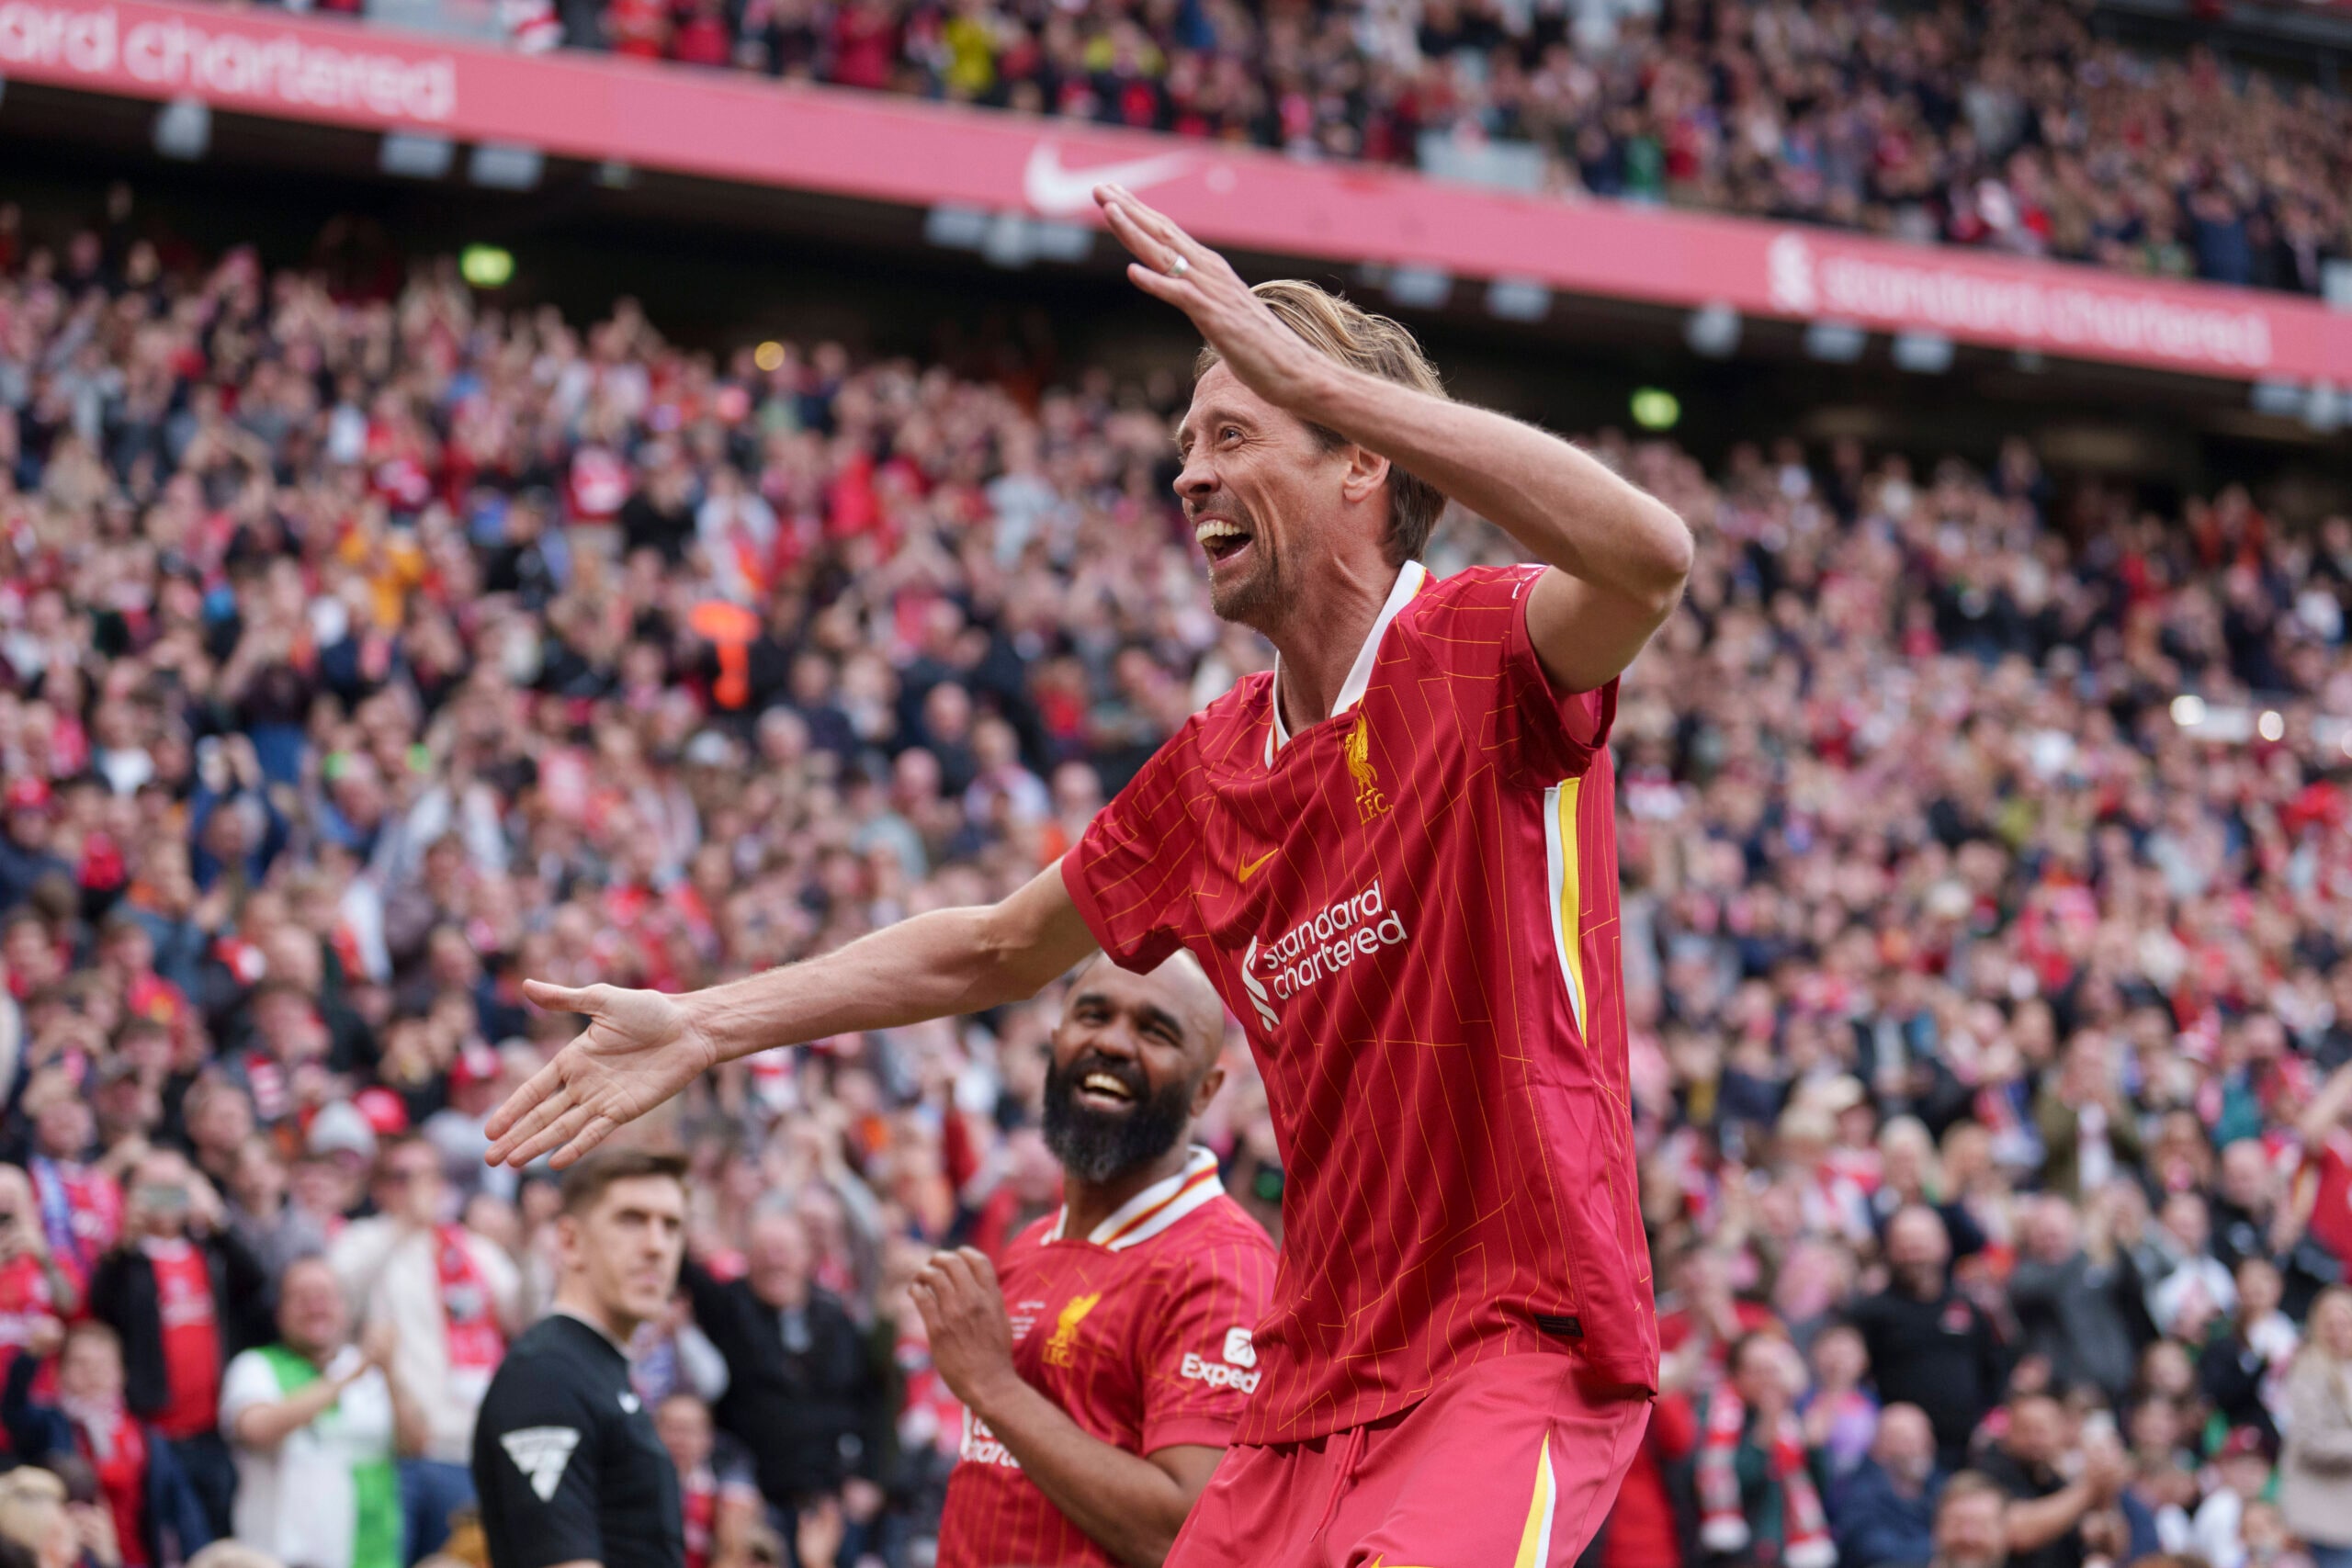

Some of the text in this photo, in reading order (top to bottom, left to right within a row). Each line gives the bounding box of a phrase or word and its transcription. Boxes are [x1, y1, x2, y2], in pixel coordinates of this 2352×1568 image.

[123, 17, 457, 120] chartered
[1263, 880, 1383, 970] standard
[1273, 909, 1408, 1000] chartered
[1181, 1352, 1261, 1394] Exped
